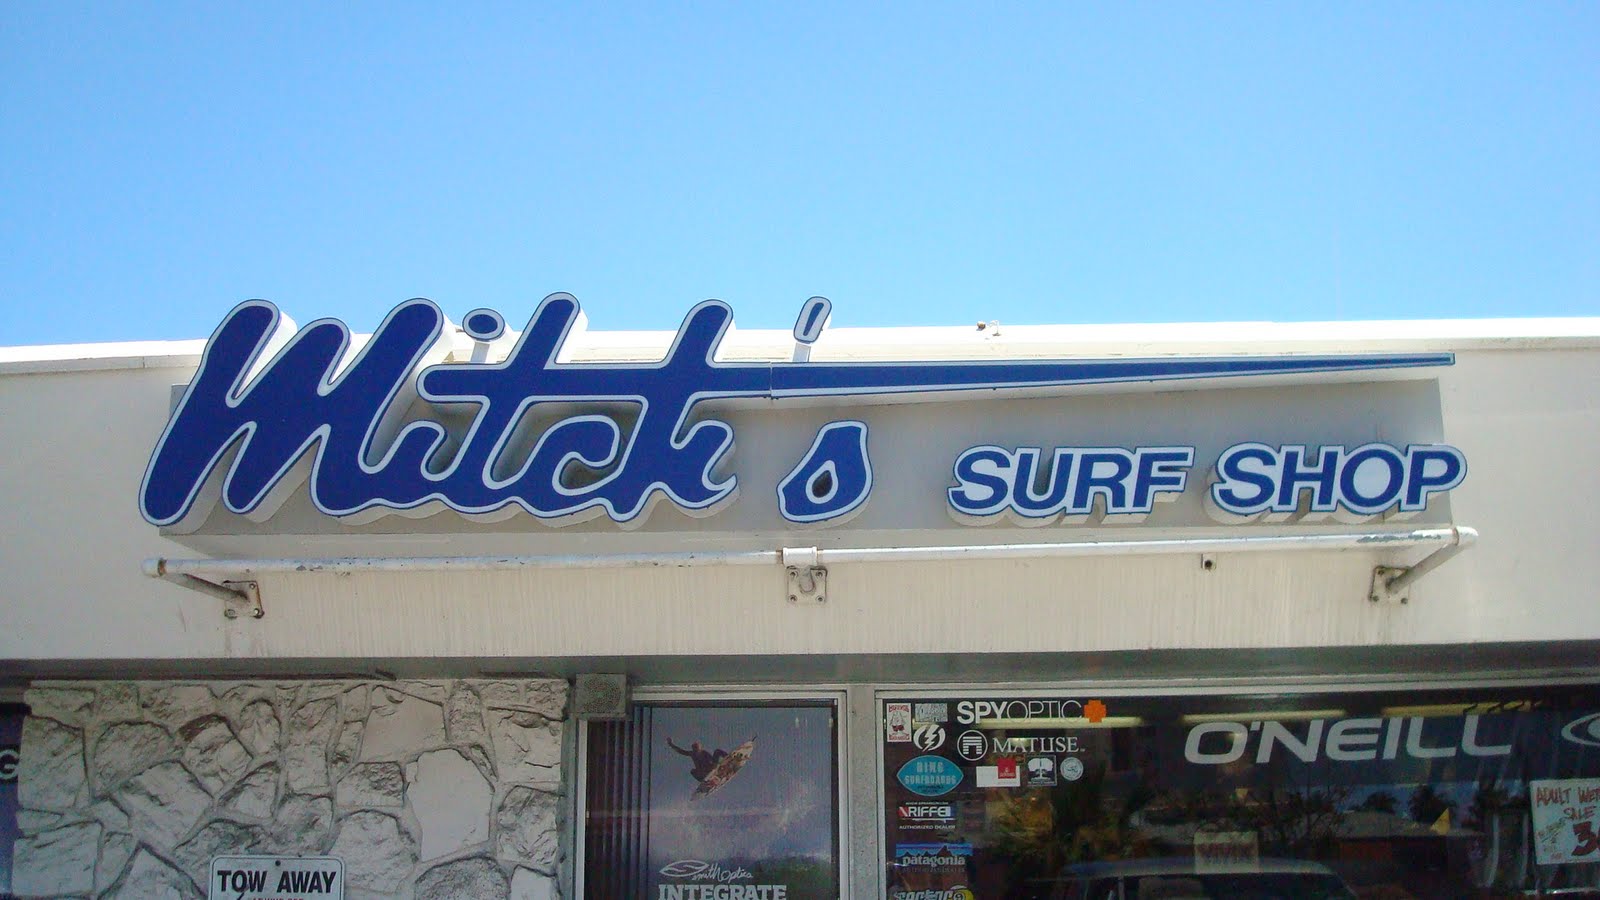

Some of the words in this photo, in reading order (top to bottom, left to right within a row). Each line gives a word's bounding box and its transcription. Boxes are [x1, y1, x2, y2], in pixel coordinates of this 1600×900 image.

[138, 292, 873, 524] Mitch's
[948, 445, 1195, 517] SURF
[1212, 442, 1467, 515] SHOP
[1184, 713, 1512, 765] O'NEILL
[902, 855, 966, 867] patagonia
[217, 870, 268, 892] TOW
[277, 870, 336, 893] AWAY
[658, 884, 787, 900] INTEGRATE
